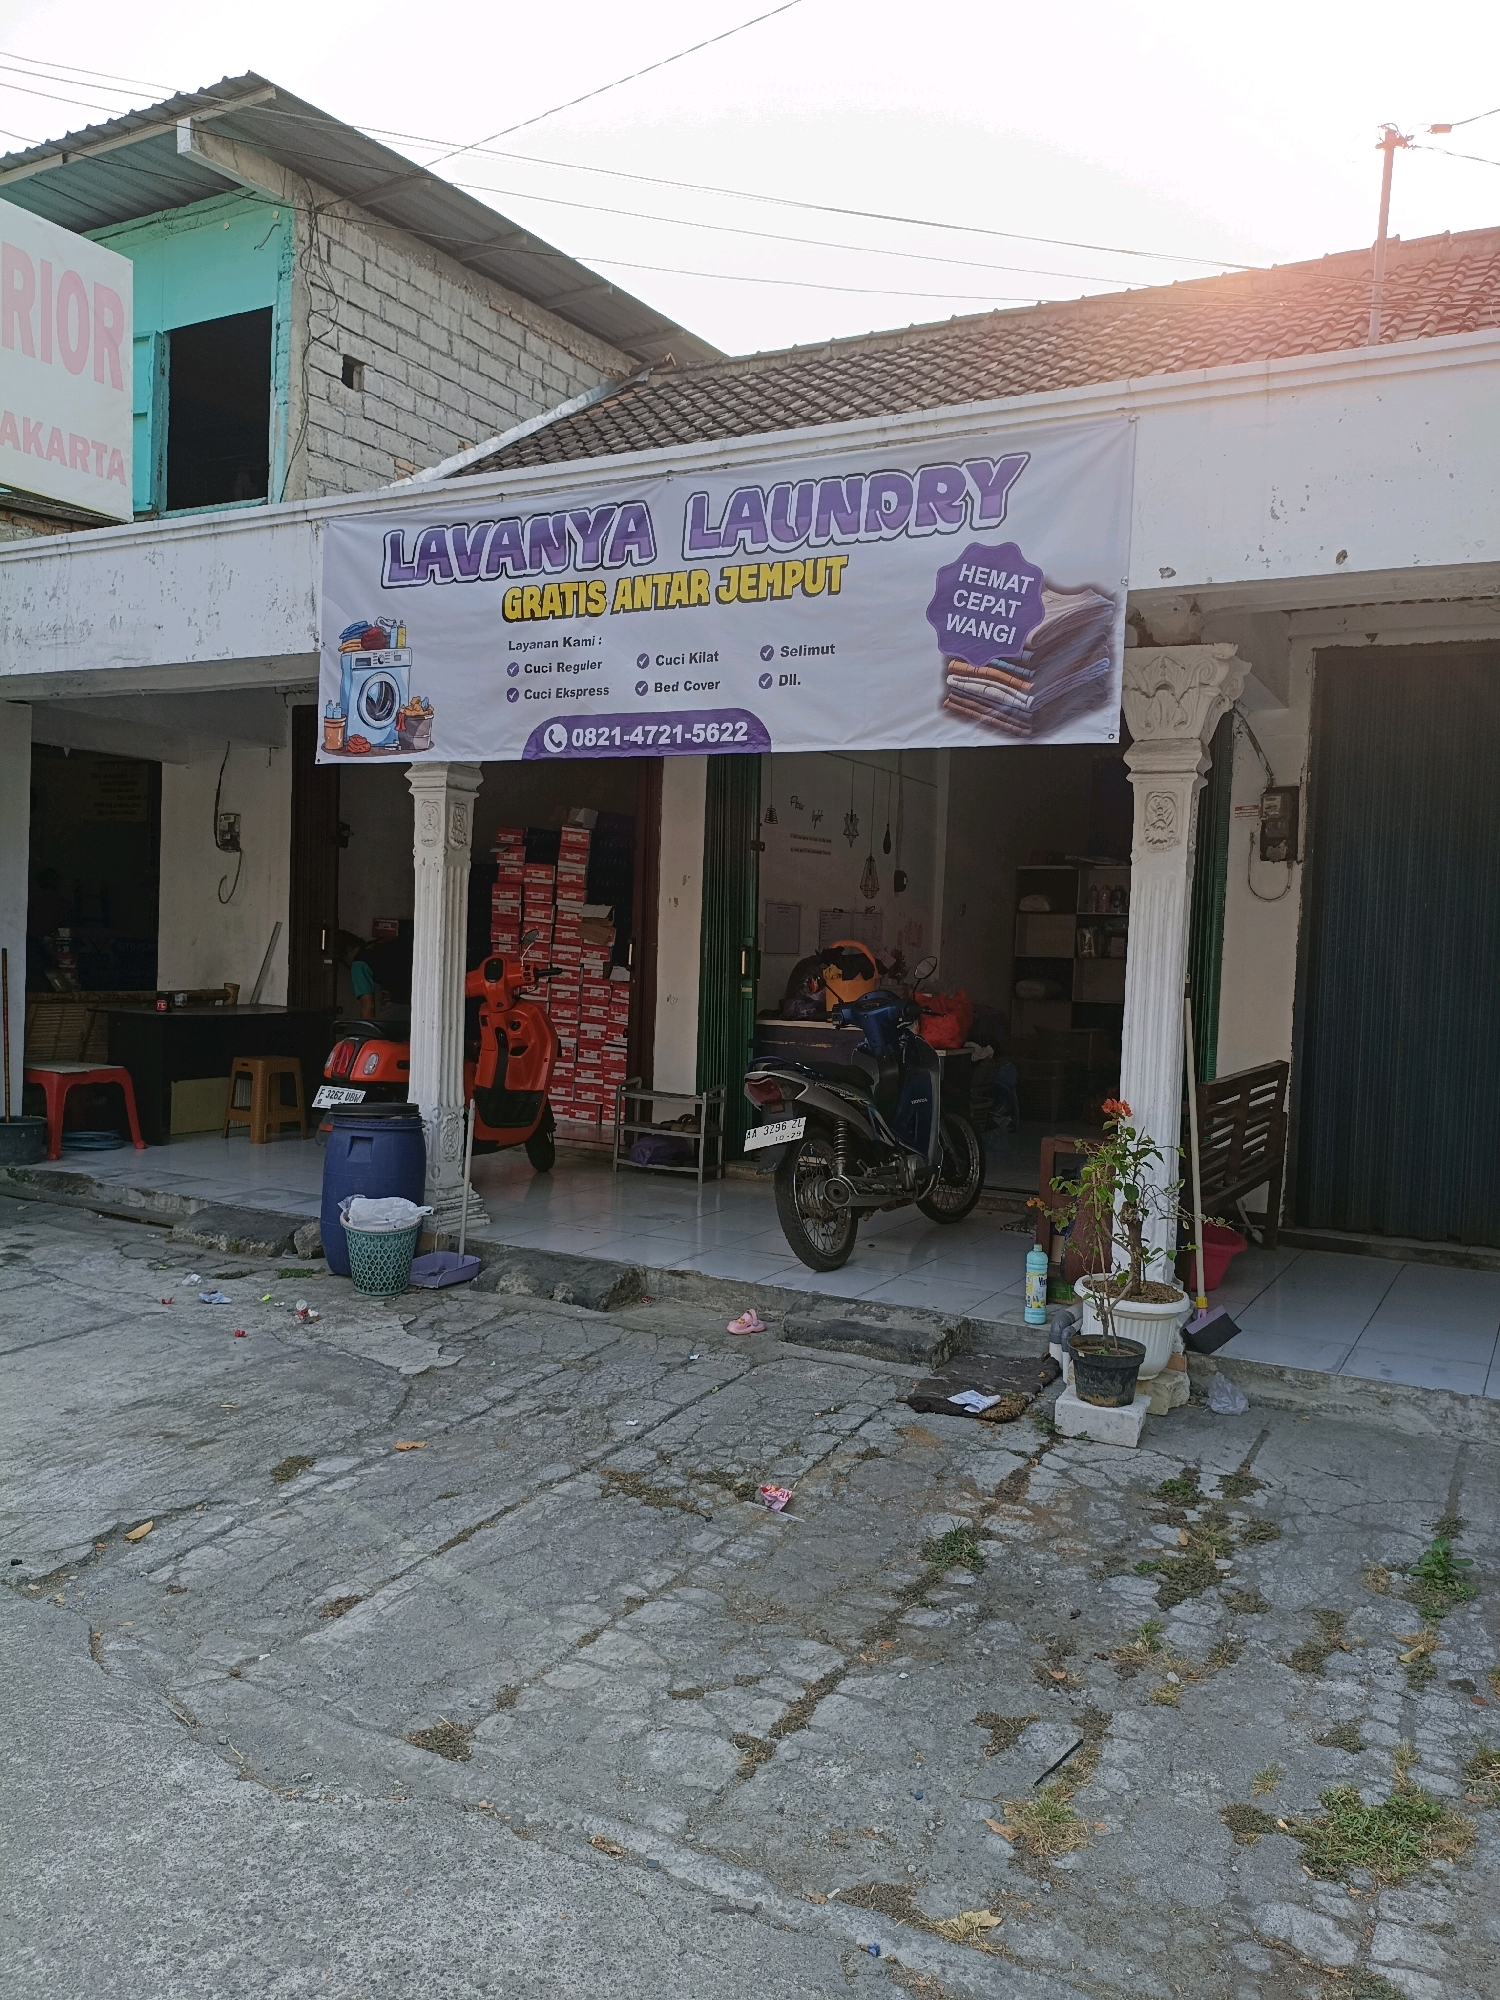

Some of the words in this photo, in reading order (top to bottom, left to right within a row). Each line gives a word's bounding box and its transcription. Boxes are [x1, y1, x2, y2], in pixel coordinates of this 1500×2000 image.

[2, 241, 124, 392] RIOR
[0, 410, 127, 486] AKARTA
[382, 501, 656, 588] LAVANYA
[683, 453, 1031, 560] LAUNDRY
[958, 563, 1034, 594] HEMAT
[502, 579, 608, 622] GRATIS
[611, 568, 710, 614] ANTAR
[716, 555, 849, 603] JEMPUT
[953, 589, 1021, 618] CEPAT
[946, 613, 1017, 645] WANGI
[508, 639, 559, 652] Layanan
[562, 635, 596, 648] Kami
[780, 643, 836, 658] Selimut
[655, 653, 685, 666] Cuci
[689, 650, 719, 665] Kilat
[524, 663, 552, 674] Cuci
[556, 660, 603, 674] Reguler
[654, 681, 680, 693] Bed
[683, 679, 721, 692] Cover
[778, 674, 802, 687] Dll.
[524, 688, 551, 700] Cuci
[555, 686, 610, 699] Ekspress
[571, 721, 749, 747] 0821-4721-5622
[319, 1089, 325, 1097] F
[326, 1089, 344, 1100] 3262
[746, 1130, 757, 1139] AA
[764, 1122, 786, 1135] 3296
